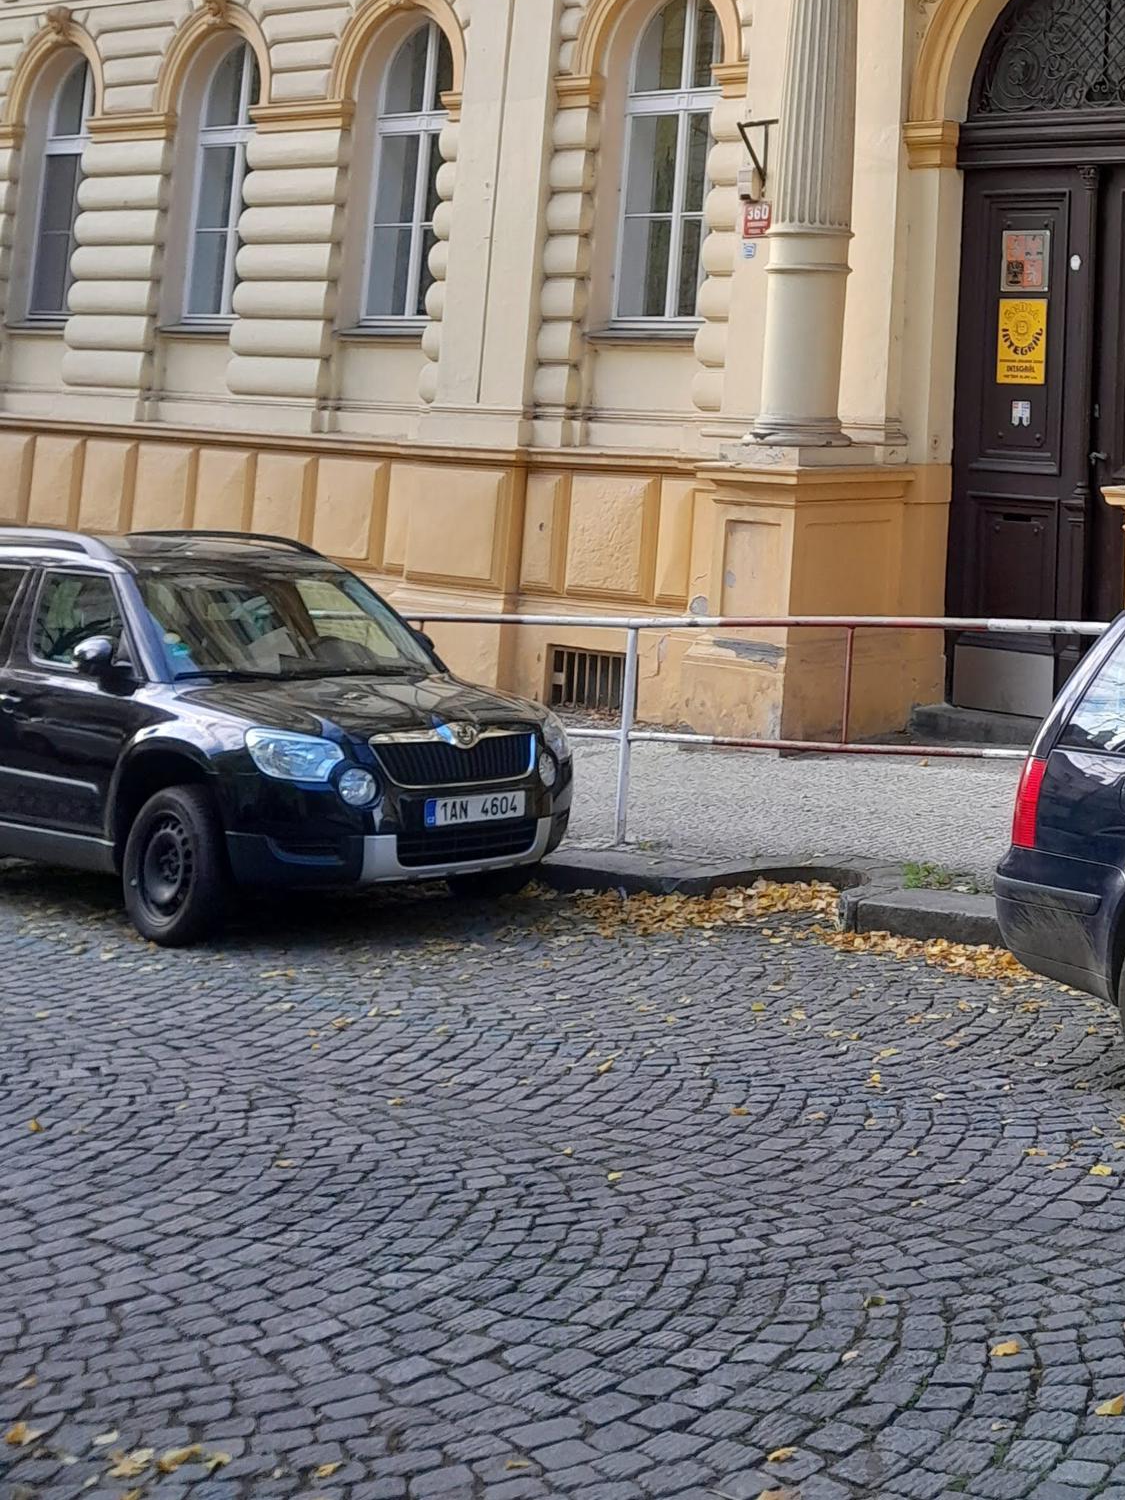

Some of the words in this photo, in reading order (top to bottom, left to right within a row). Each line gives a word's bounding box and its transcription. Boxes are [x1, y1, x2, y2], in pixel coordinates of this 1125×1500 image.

[747, 204, 769, 220] 360
[441, 801, 468, 821] 1AN
[481, 794, 517, 816] 4604
